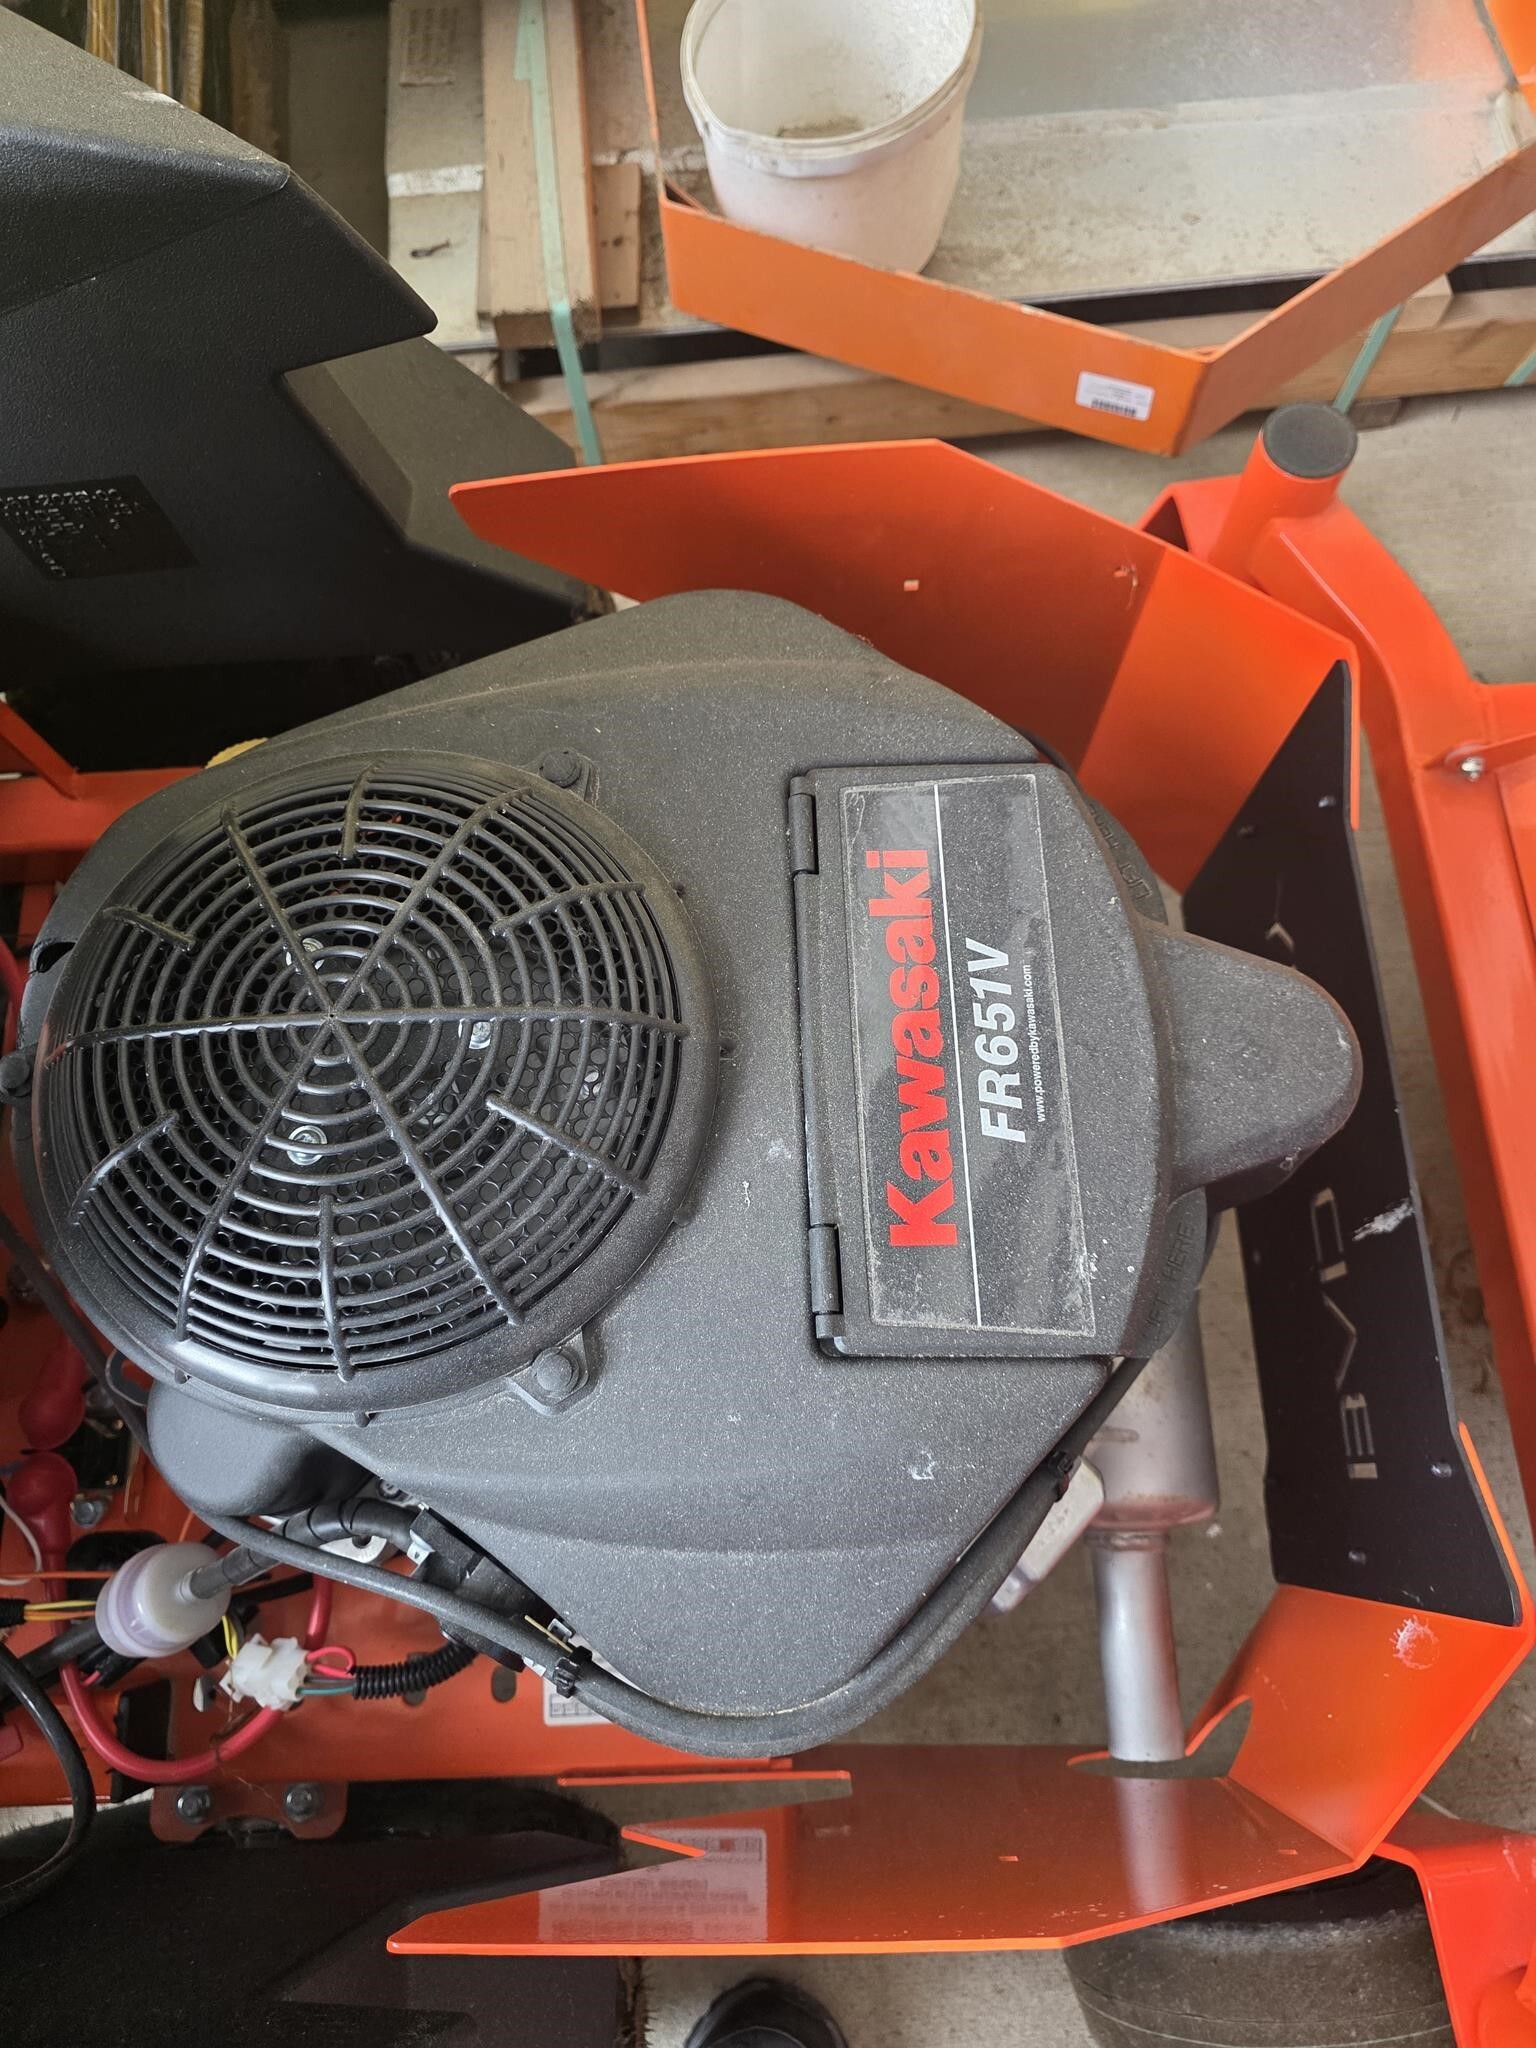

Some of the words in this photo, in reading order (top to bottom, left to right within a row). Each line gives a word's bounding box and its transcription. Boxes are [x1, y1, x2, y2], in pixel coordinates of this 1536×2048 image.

[866, 850, 958, 1247] Kawasaki
[965, 937, 1027, 1144] FR651V
[1022, 963, 1047, 1124] www.poweredbykawasaki.com
[1161, 1221, 1196, 1281] HERE
